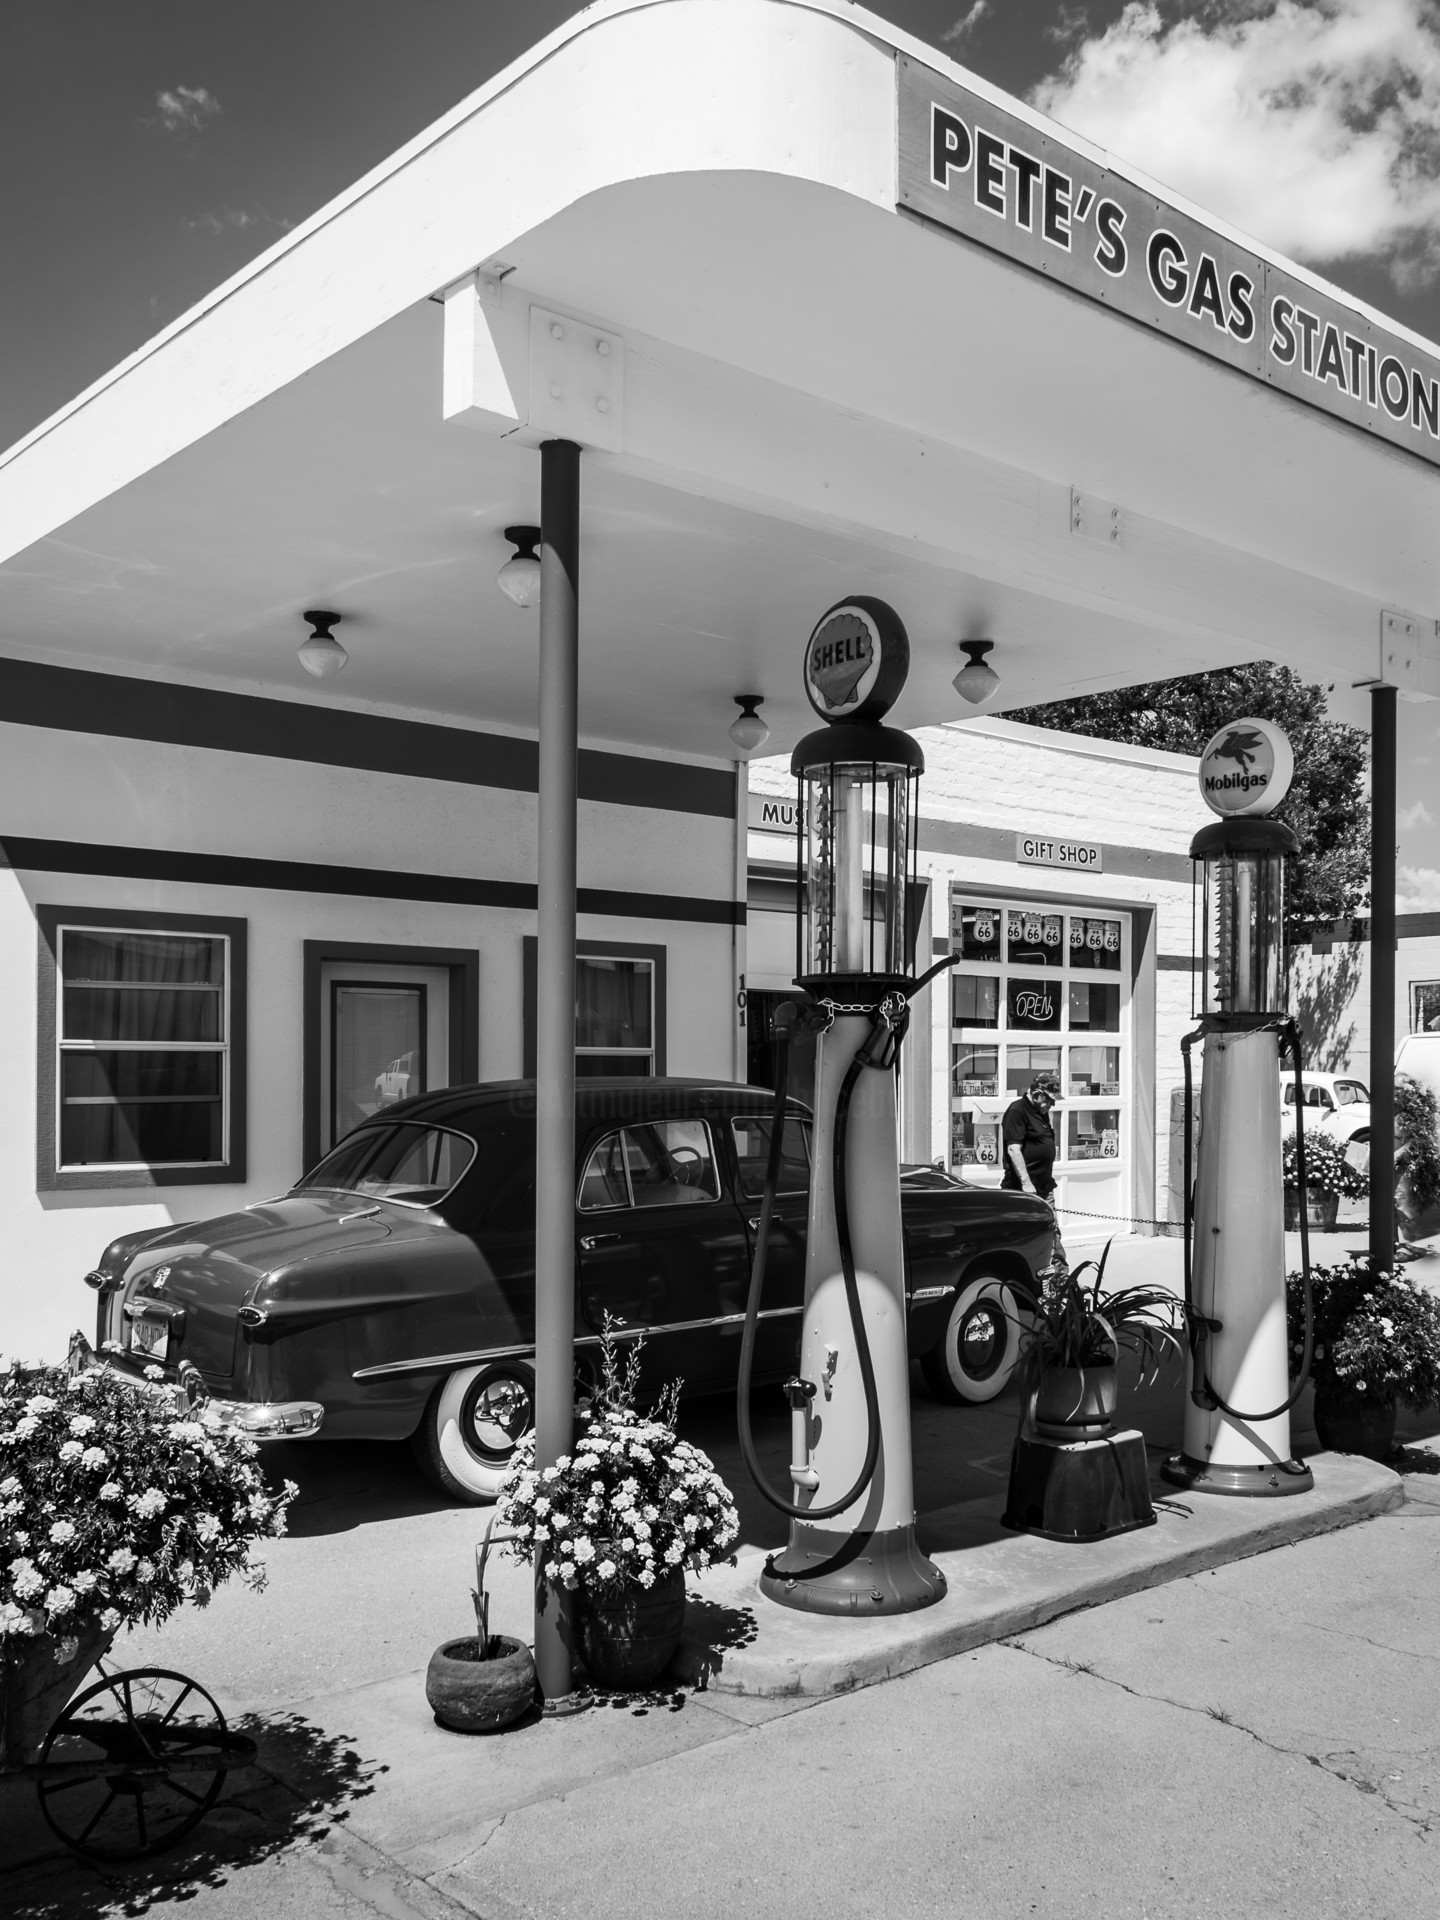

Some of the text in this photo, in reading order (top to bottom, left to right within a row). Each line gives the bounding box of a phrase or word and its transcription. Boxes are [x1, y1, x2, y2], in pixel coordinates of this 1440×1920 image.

[931, 101, 1440, 440] PETE'S GAS STATION
[814, 636, 866, 671] SHELL
[1205, 773, 1268, 792] Mobilgas
[761, 802, 808, 828] MUS
[1023, 839, 1097, 865] GIFT SHOP
[978, 926, 991, 938] 66
[1007, 926, 1020, 937] 66
[1027, 928, 1040, 940] 66
[1046, 931, 1058, 942] 66
[1070, 933, 1081, 944] 66
[1090, 935, 1101, 946] 66
[1107, 937, 1118, 948] 66
[1016, 996, 1052, 1017] OPEN
[981, 1150, 994, 1161] 66
[1104, 1145, 1115, 1155] 66
